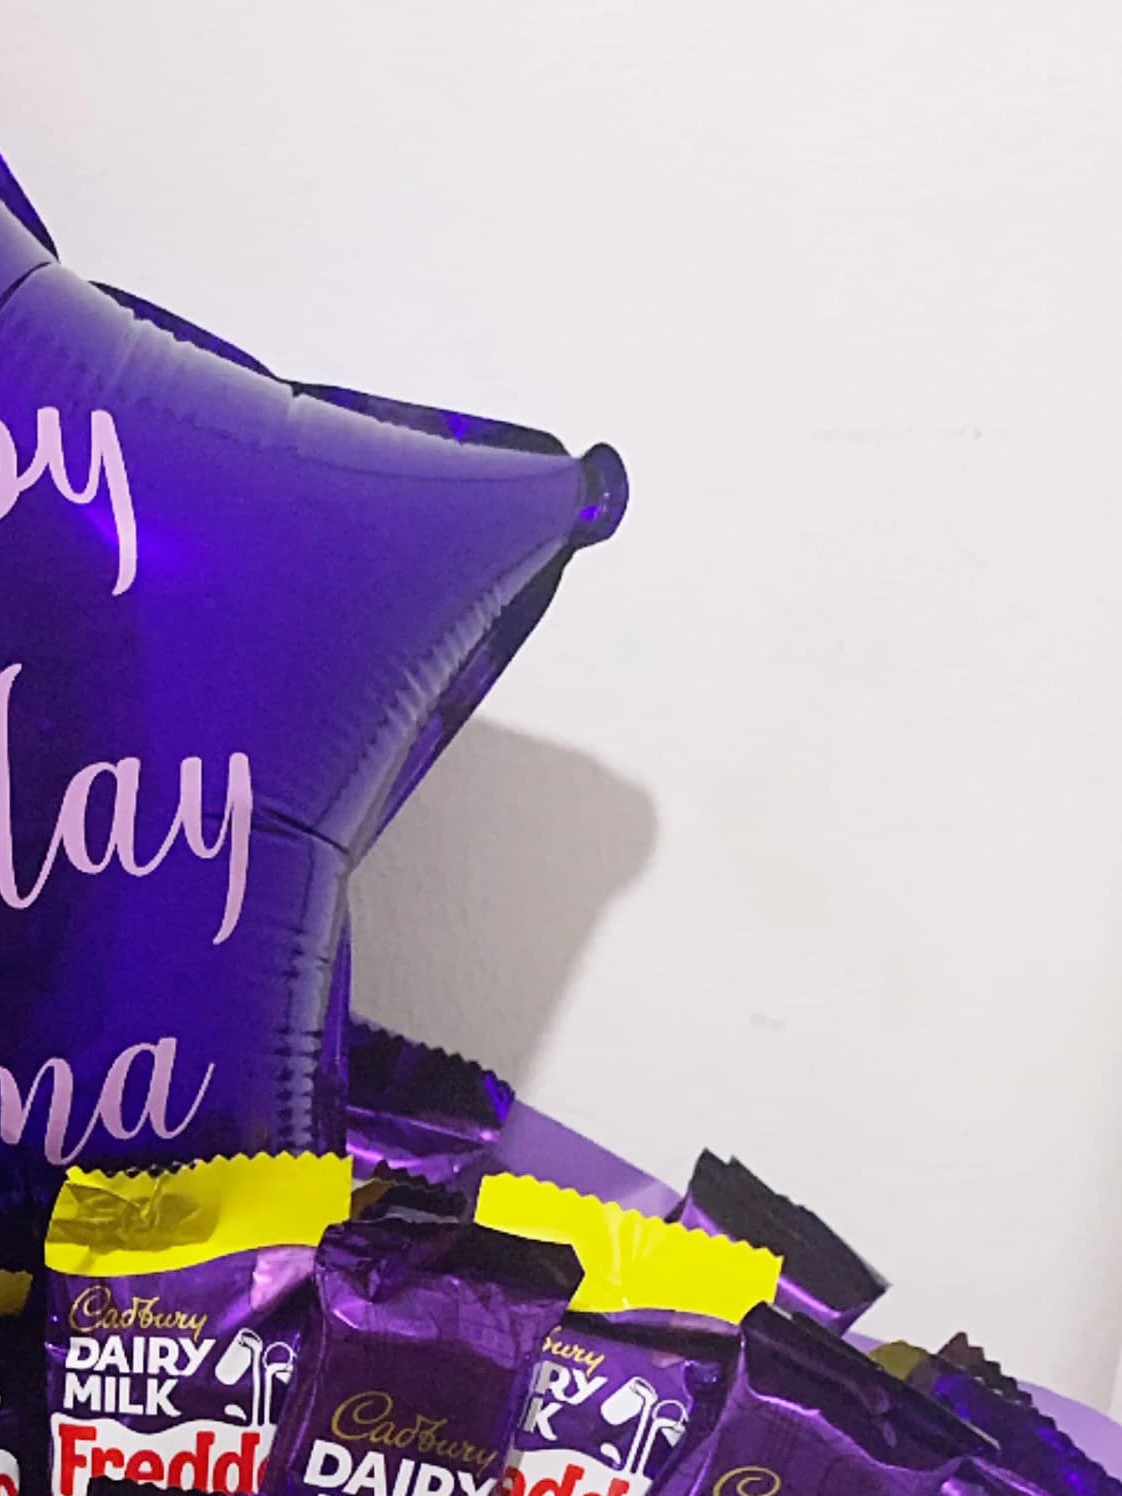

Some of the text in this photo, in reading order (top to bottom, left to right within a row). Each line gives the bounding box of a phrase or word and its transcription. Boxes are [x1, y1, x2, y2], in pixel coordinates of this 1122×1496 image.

[69, 1285, 208, 1341] Cadbury
[65, 1336, 216, 1377] DAIRY
[62, 1372, 181, 1419] MILK
[331, 1391, 499, 1477] Cadbury
